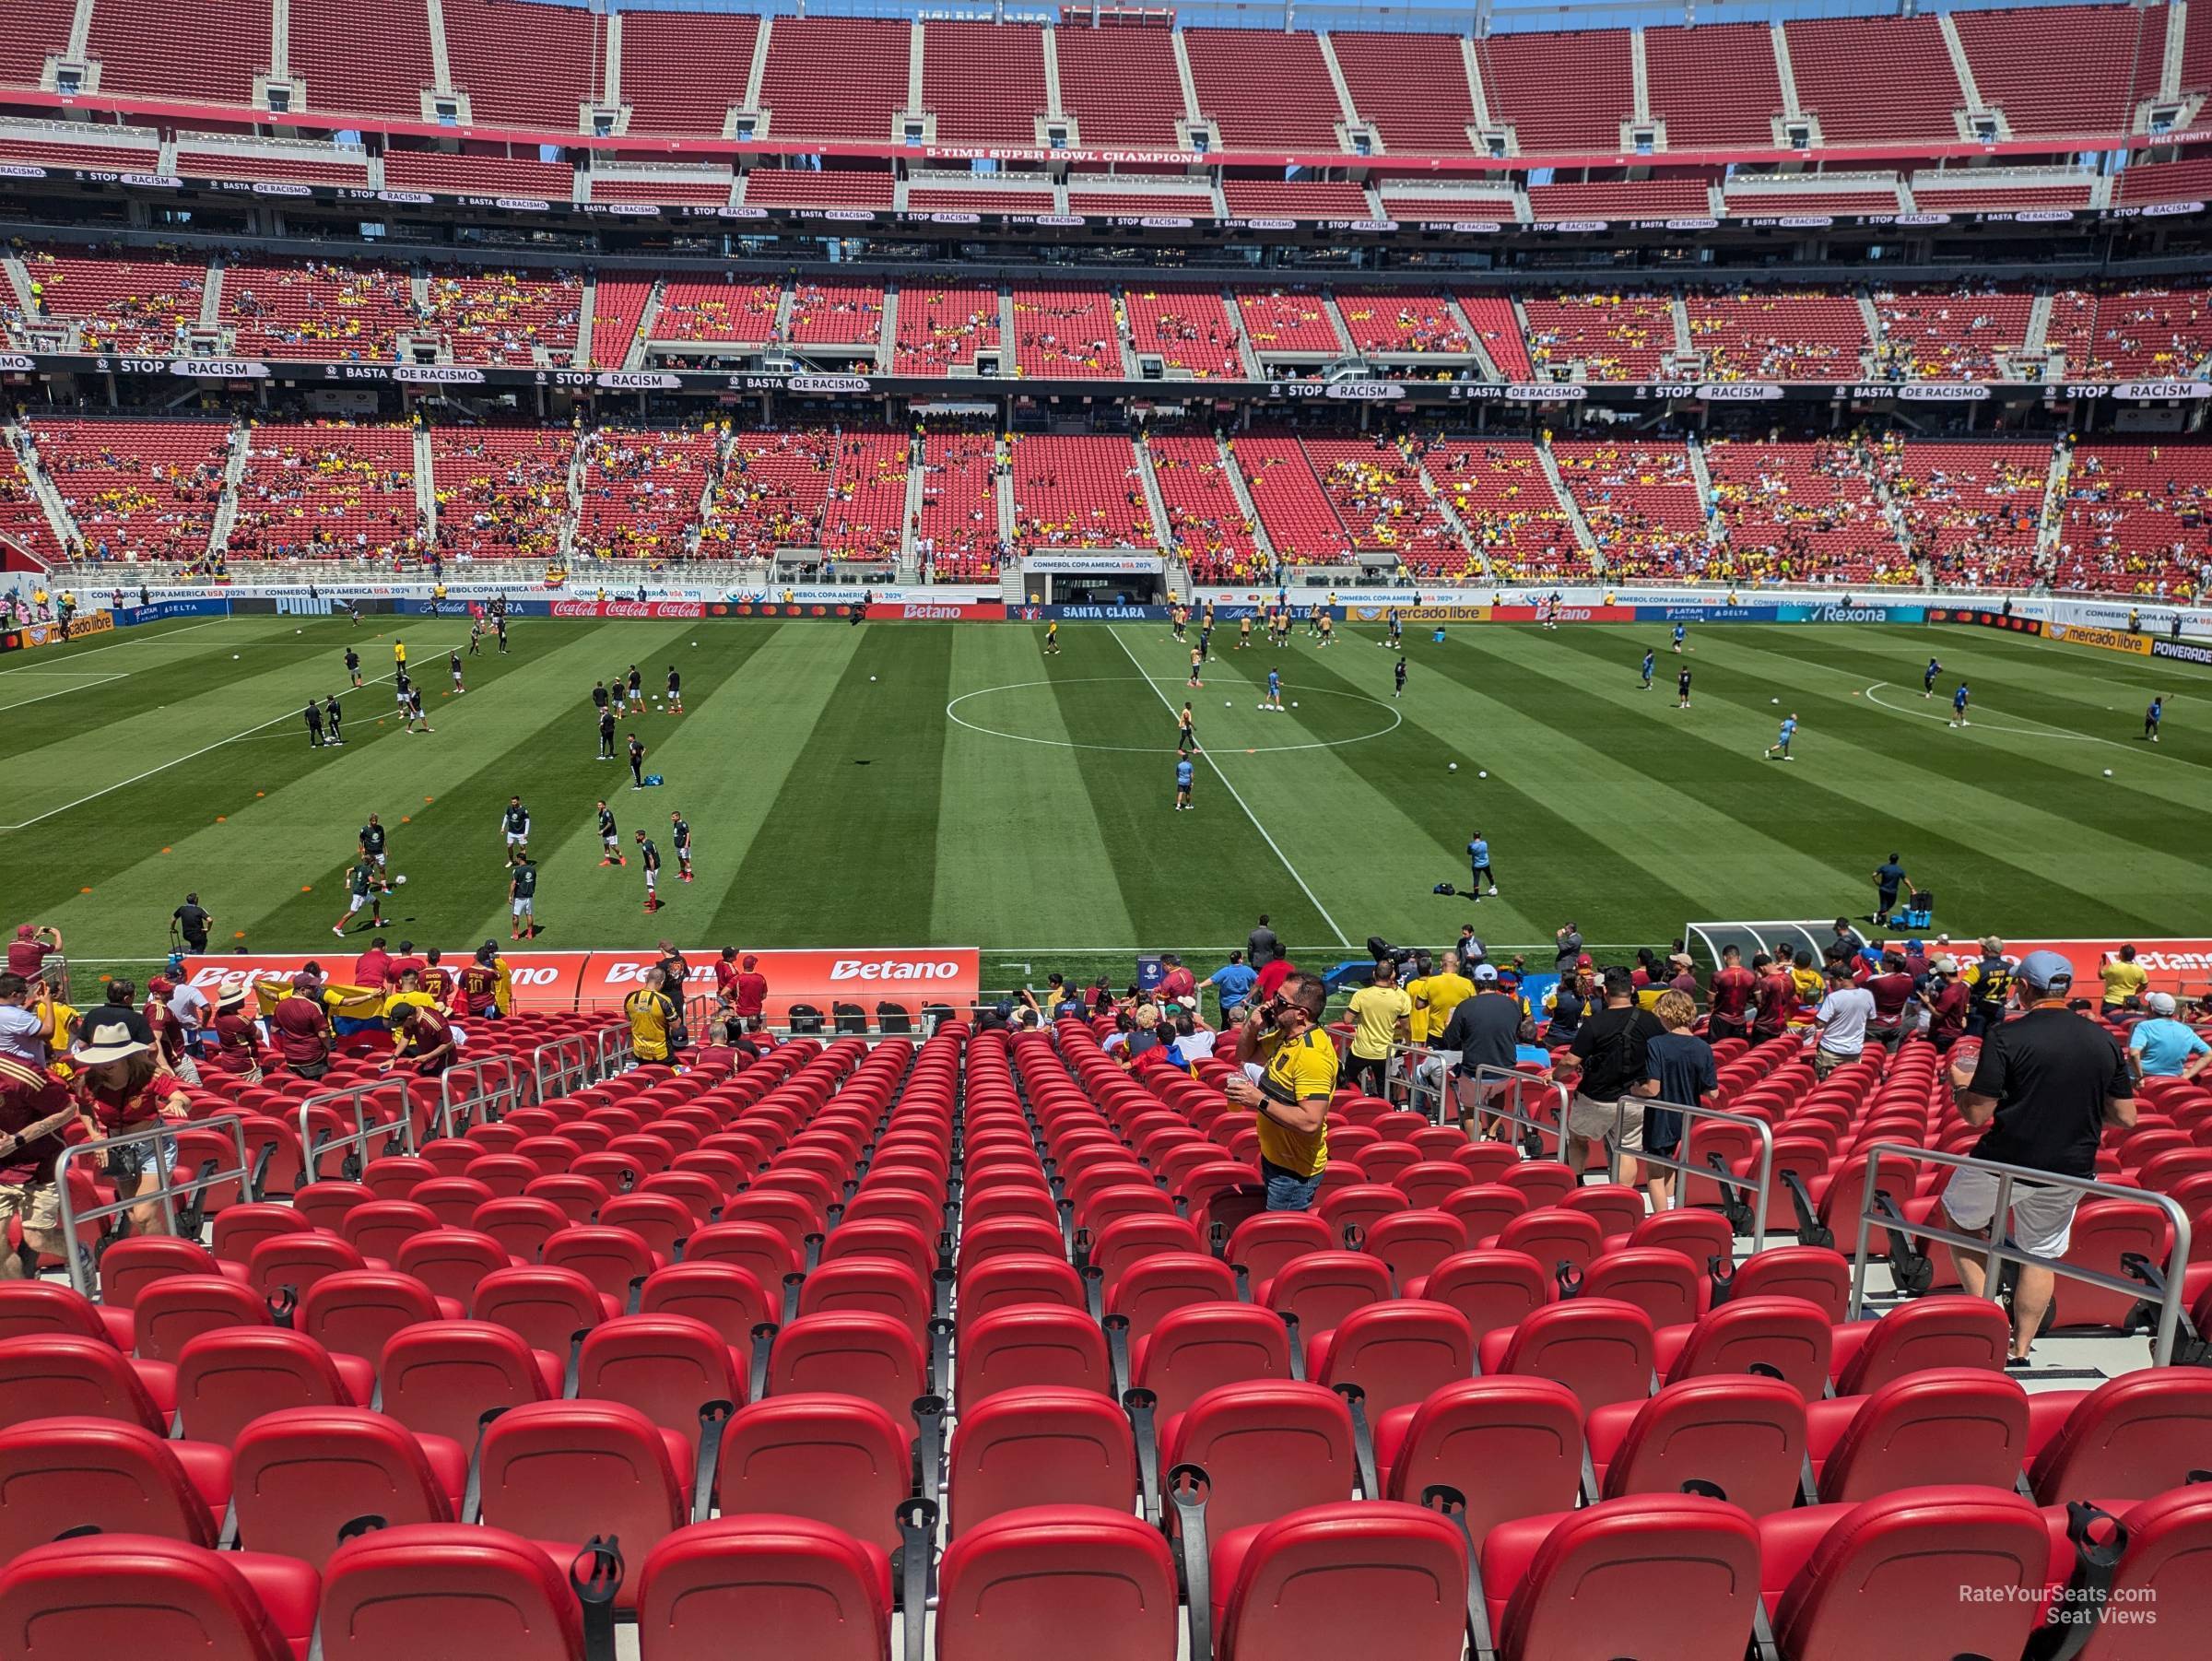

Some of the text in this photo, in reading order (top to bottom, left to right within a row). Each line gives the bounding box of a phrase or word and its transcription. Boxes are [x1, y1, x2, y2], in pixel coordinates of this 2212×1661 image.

[2148, 131, 2212, 146] FREE XFINITY
[926, 147, 1204, 163] 5-TIME SUPER BOWL CHAMPIONS
[0, 167, 41, 176] RACISMO
[90, 172, 170, 185] STOP RACISM
[223, 183, 250, 191] BASTA
[269, 184, 308, 194] RACISMO
[350, 189, 422, 202] STOP RACISM
[469, 197, 494, 206] BASTA
[512, 201, 546, 209] RACISMO
[584, 205, 606, 213] BASTA
[694, 206, 758, 217] STOP RACISM
[2113, 204, 2191, 218] STOP RACISM
[908, 213, 930, 221] STOP
[1869, 215, 1938, 224] STOP RACISM
[1987, 213, 2013, 221] BASTA
[2031, 211, 2069, 220] RACISMO
[1117, 218, 1139, 226] STOP
[1224, 219, 1246, 228] BASTA
[1328, 221, 1349, 230] STOP
[1533, 222, 1596, 231] STOP RACISM
[121, 360, 248, 375] STOP RACISM
[347, 367, 478, 381] BASTA DE RACISMO
[556, 372, 662, 386] STOP RACISM
[747, 378, 864, 390] BASTA DE RACISMO
[1288, 385, 1387, 396] STOP RACISM
[1467, 387, 1581, 397] BASTA DE RACISMO
[1655, 387, 1764, 398] STOP RACISM
[1853, 387, 1983, 397] BASTA DE RACISMO
[2066, 385, 2192, 398] STOP RACISM
[140, 607, 159, 616] LATAM
[169, 605, 197, 613] DELTA
[276, 598, 332, 615] PUMA
[903, 604, 961, 618] Betano
[1064, 607, 1145, 618] SANTA CLARA
[1450, 607, 1479, 618] libre
[1824, 607, 1887, 622] Rexona
[91, 615, 111, 630] libre
[2069, 628, 2142, 651] mercado libre
[2153, 642, 2212, 664] POWERADE
[830, 960, 959, 981] Betano
[468, 979, 483, 994] 10
